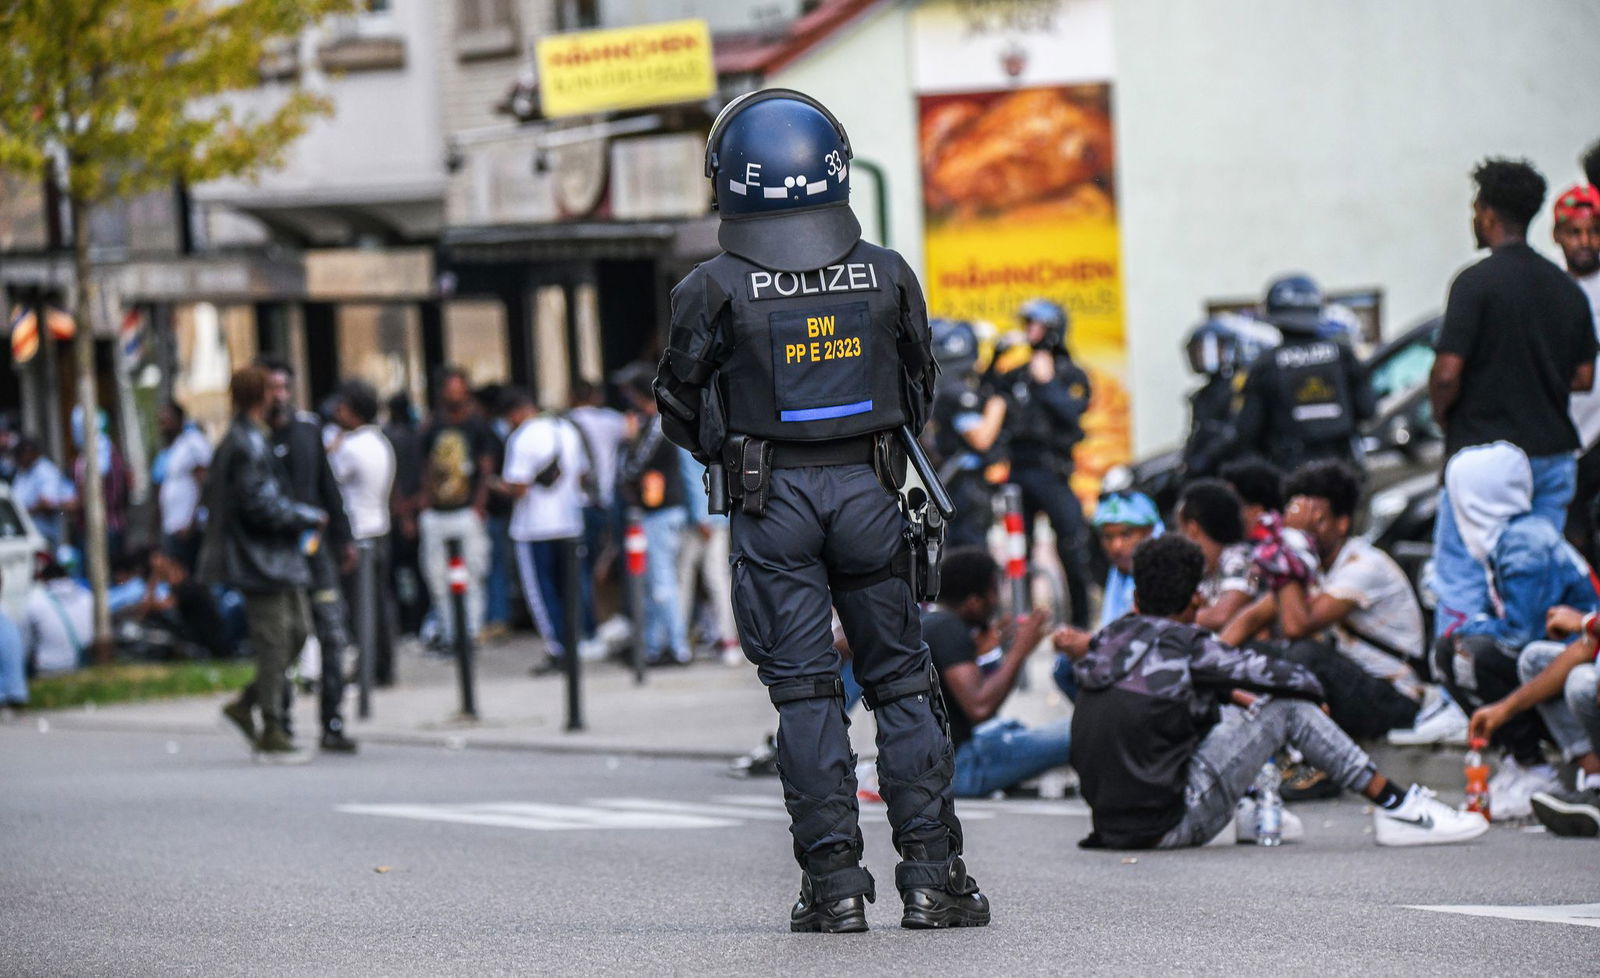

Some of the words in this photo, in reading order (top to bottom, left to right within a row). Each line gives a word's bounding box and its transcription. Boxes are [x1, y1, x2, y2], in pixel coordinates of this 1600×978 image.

[745, 163, 762, 187] E
[825, 150, 843, 176] 33
[751, 263, 878, 298] POLIZEI
[806, 315, 835, 338] BW
[785, 344, 807, 364] PP
[810, 342, 821, 362] E
[824, 336, 862, 360] 2/323
